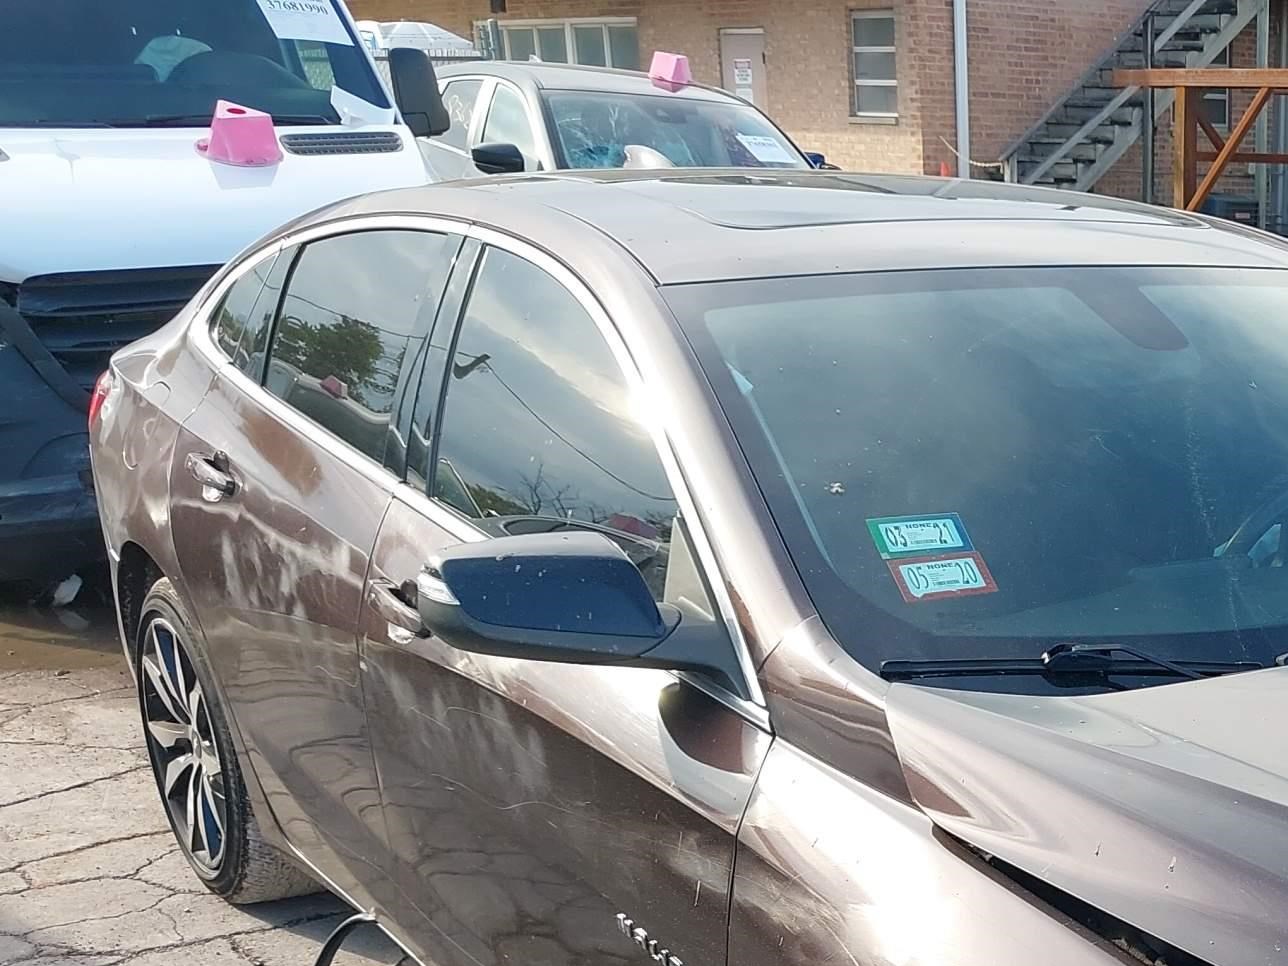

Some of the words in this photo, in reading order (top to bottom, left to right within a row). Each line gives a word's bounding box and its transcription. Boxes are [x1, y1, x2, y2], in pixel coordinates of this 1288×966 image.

[885, 526, 908, 548] 03
[933, 522, 955, 545] 21
[907, 566, 929, 590] 05
[954, 561, 978, 585] 20
